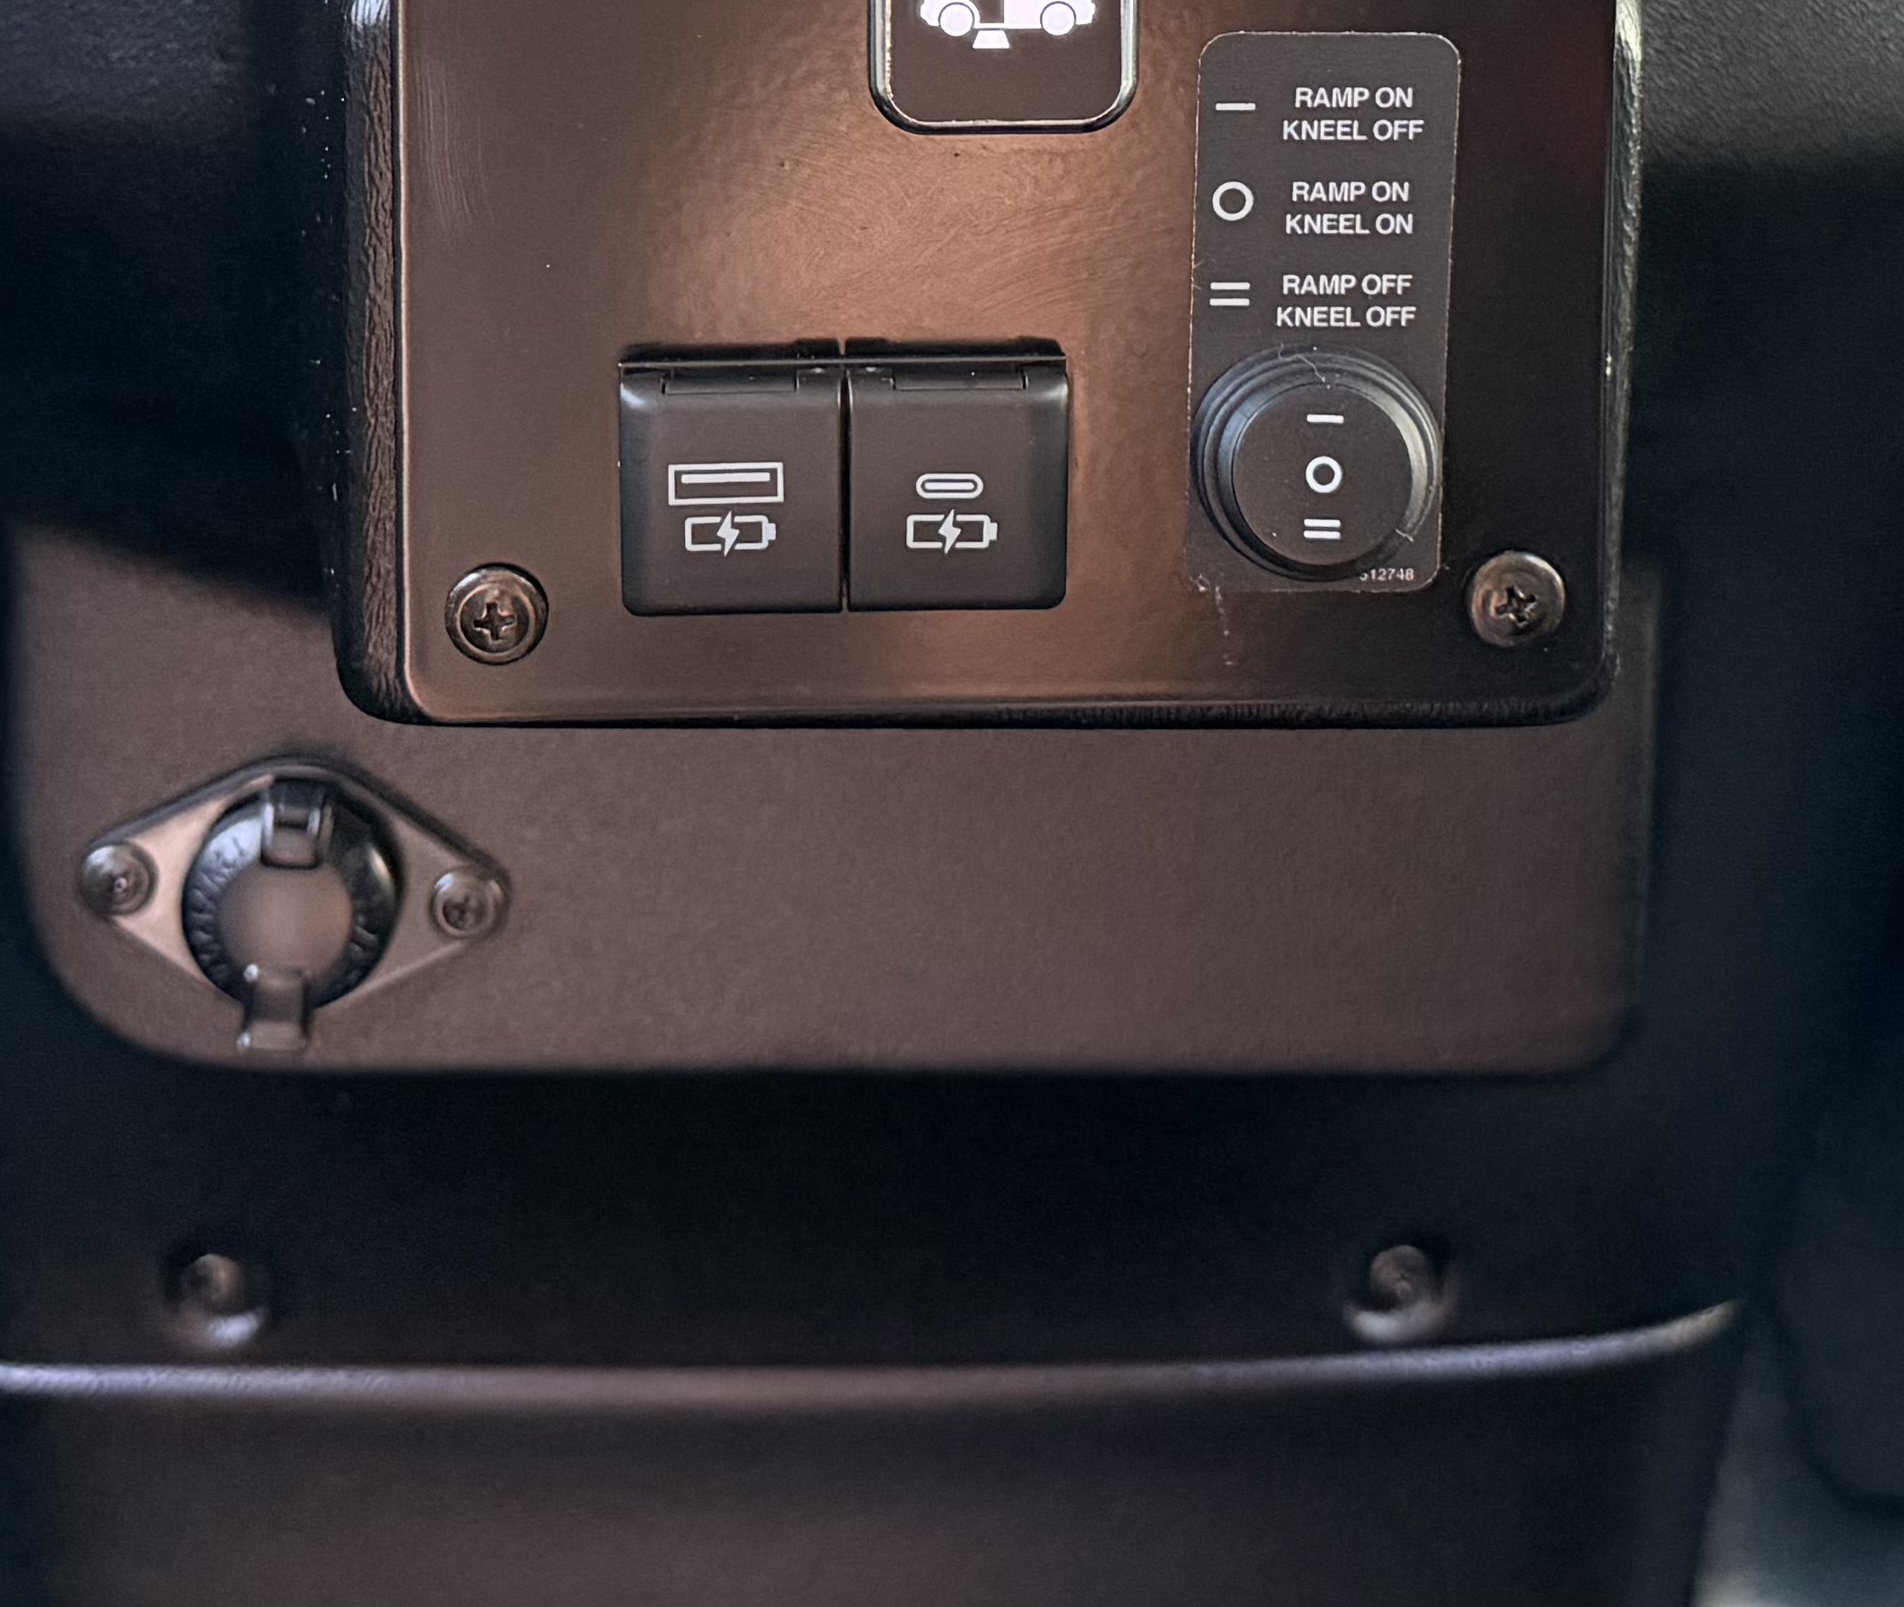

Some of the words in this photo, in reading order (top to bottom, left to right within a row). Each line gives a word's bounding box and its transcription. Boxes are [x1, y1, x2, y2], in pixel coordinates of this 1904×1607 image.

[1294, 87, 1370, 108] RAMP
[1375, 87, 1413, 108] ON
[1282, 119, 1368, 141] KNEEL
[1372, 119, 1425, 141] OFF
[1291, 181, 1366, 202] RAMP
[1371, 181, 1410, 202] ON
[1285, 213, 1370, 234] KNEEL
[1375, 213, 1414, 234] ON
[1282, 274, 1357, 295] RAMP
[1361, 274, 1413, 295] OFF
[1276, 306, 1362, 327] KNEEL
[1365, 306, 1417, 327] OFF
